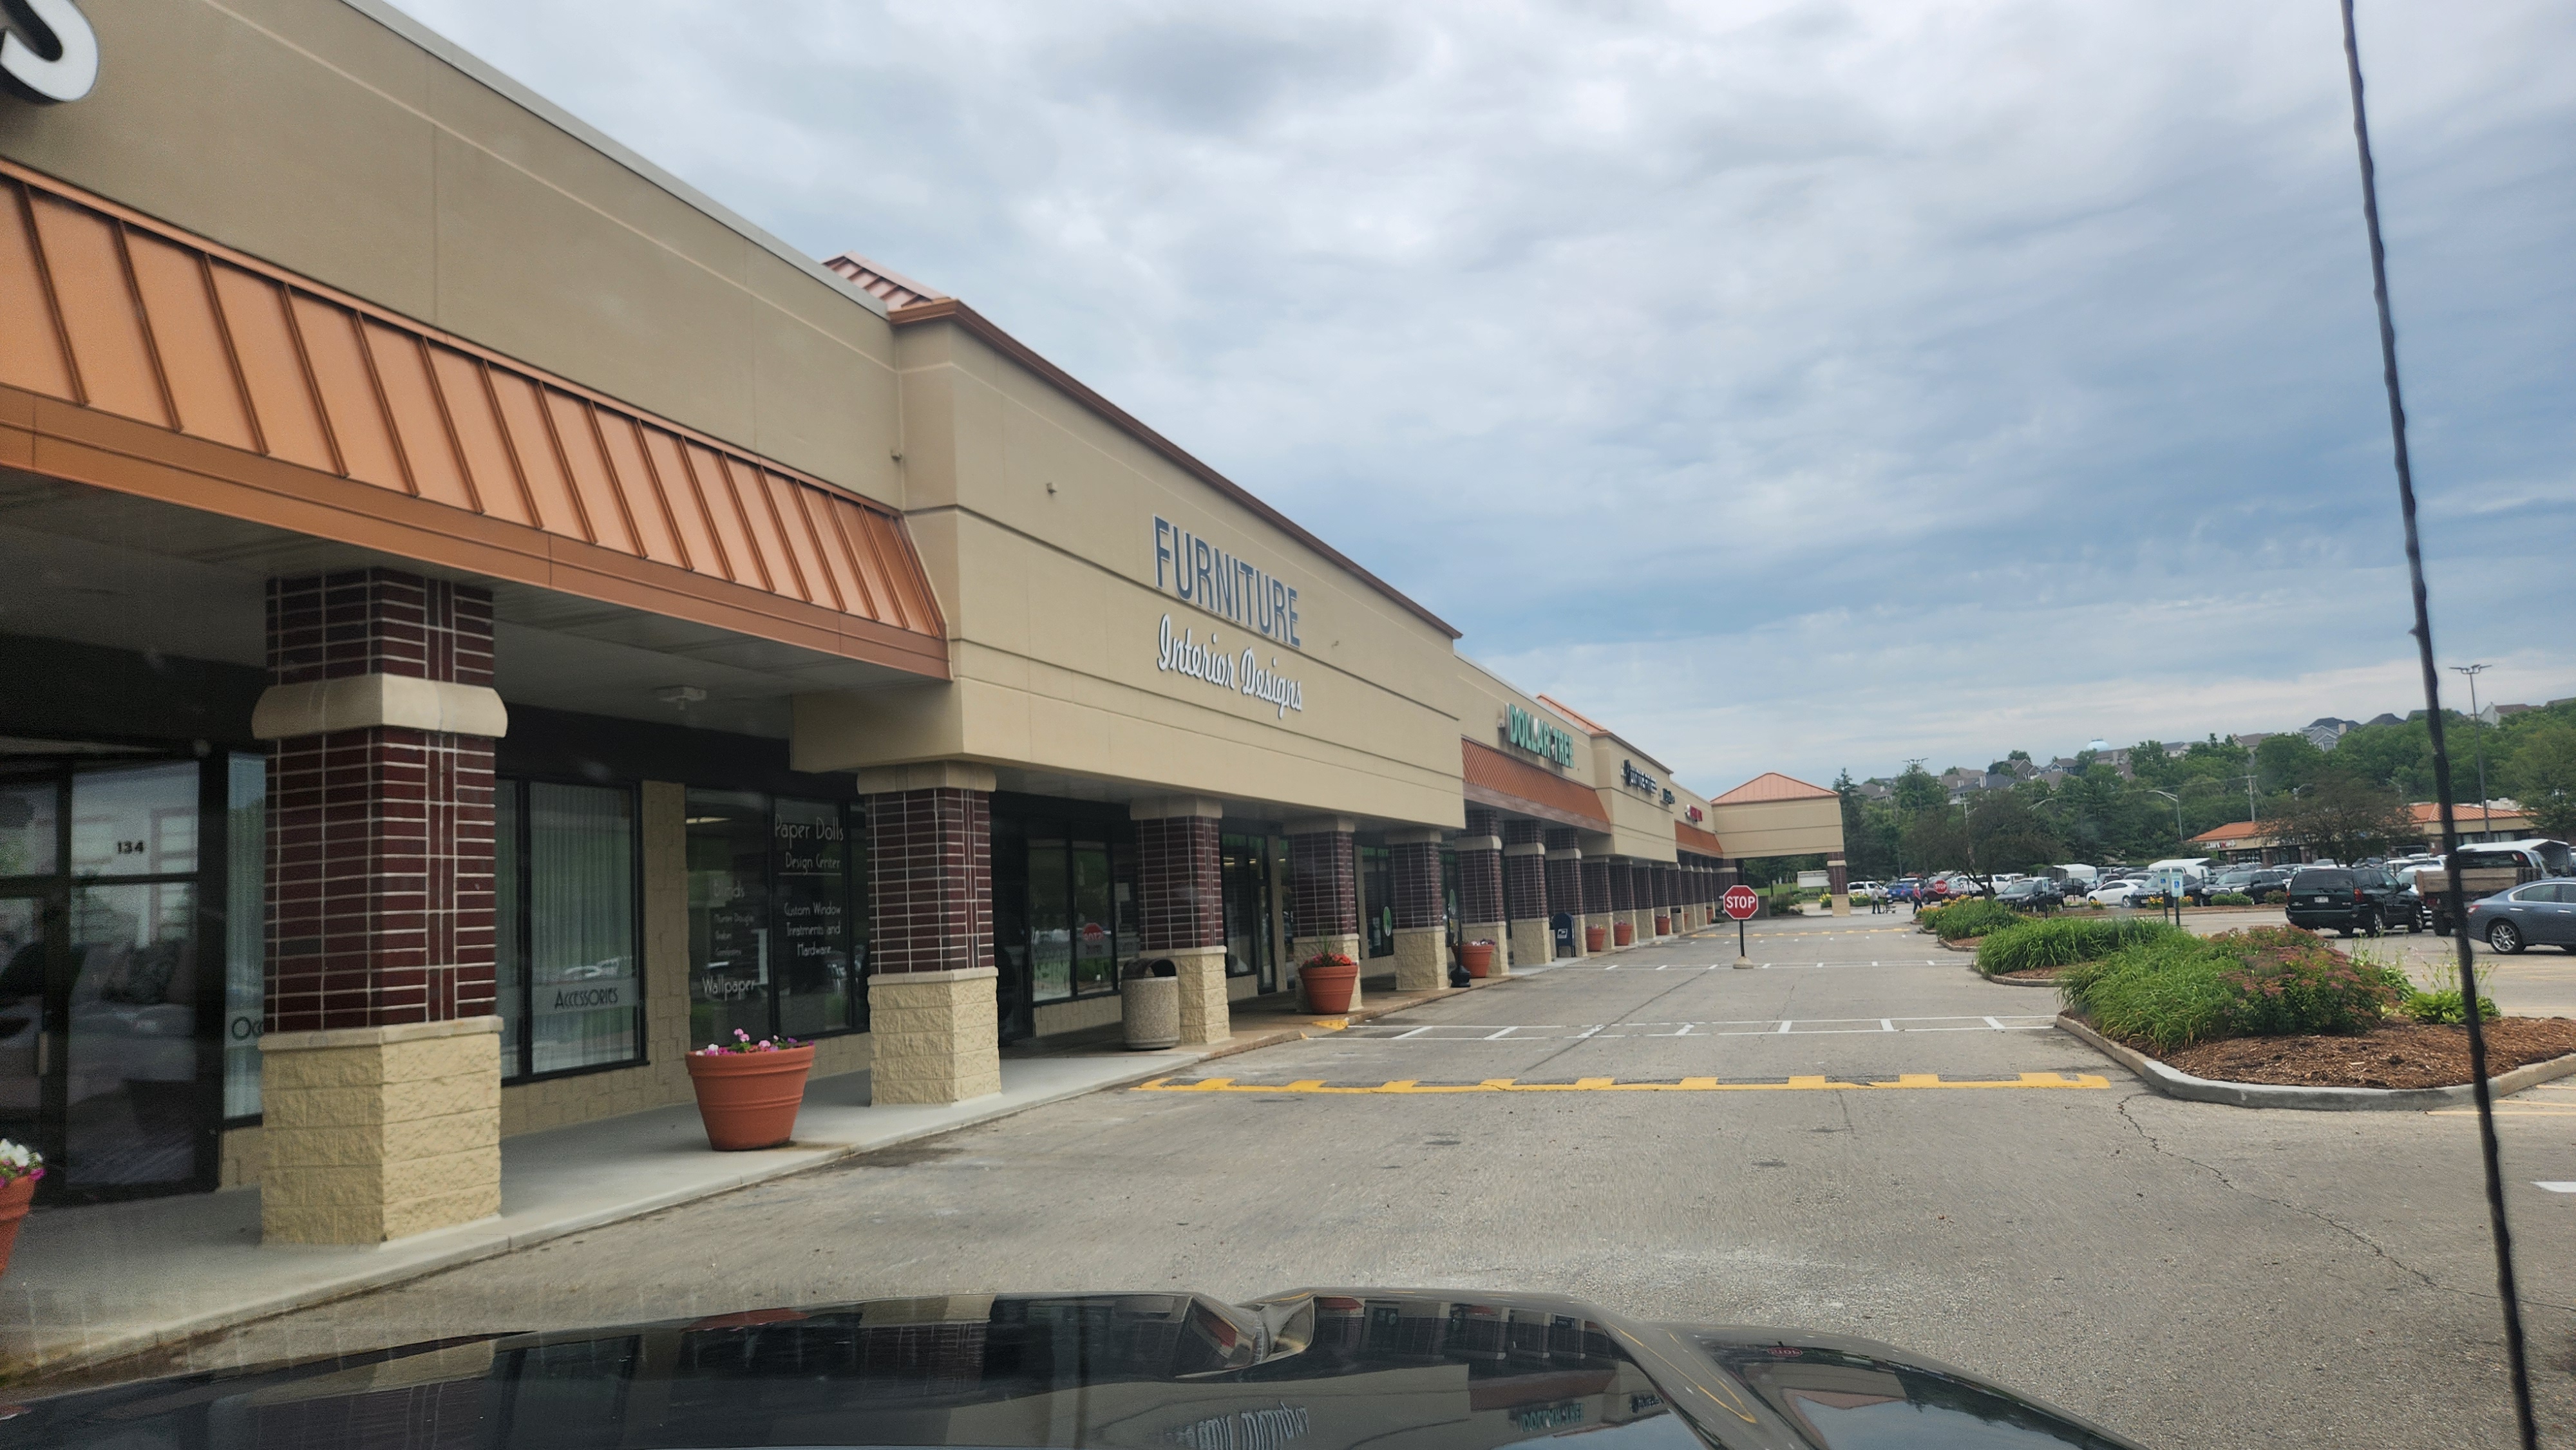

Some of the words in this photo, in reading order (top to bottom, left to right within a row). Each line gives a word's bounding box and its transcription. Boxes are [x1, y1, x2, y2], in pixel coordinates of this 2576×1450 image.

[1153, 514, 1301, 649] FURNITURE
[1157, 614, 1235, 690] Interior
[1240, 646, 1303, 719] Designs
[1508, 702, 1550, 758] DOLLAR
[1552, 726, 1575, 769] TREE
[775, 813, 810, 849] Paper
[816, 816, 844, 842] Dolls
[117, 840, 144, 854] 134
[785, 851, 813, 875] Design
[816, 853, 840, 869] Center
[784, 902, 811, 916] Custom
[813, 901, 842, 916] Window
[1726, 896, 1756, 909] STOP
[786, 921, 824, 937] Treatments
[827, 920, 841, 934] and
[797, 941, 832, 957] Hardware
[702, 974, 755, 1002] Wallpaper
